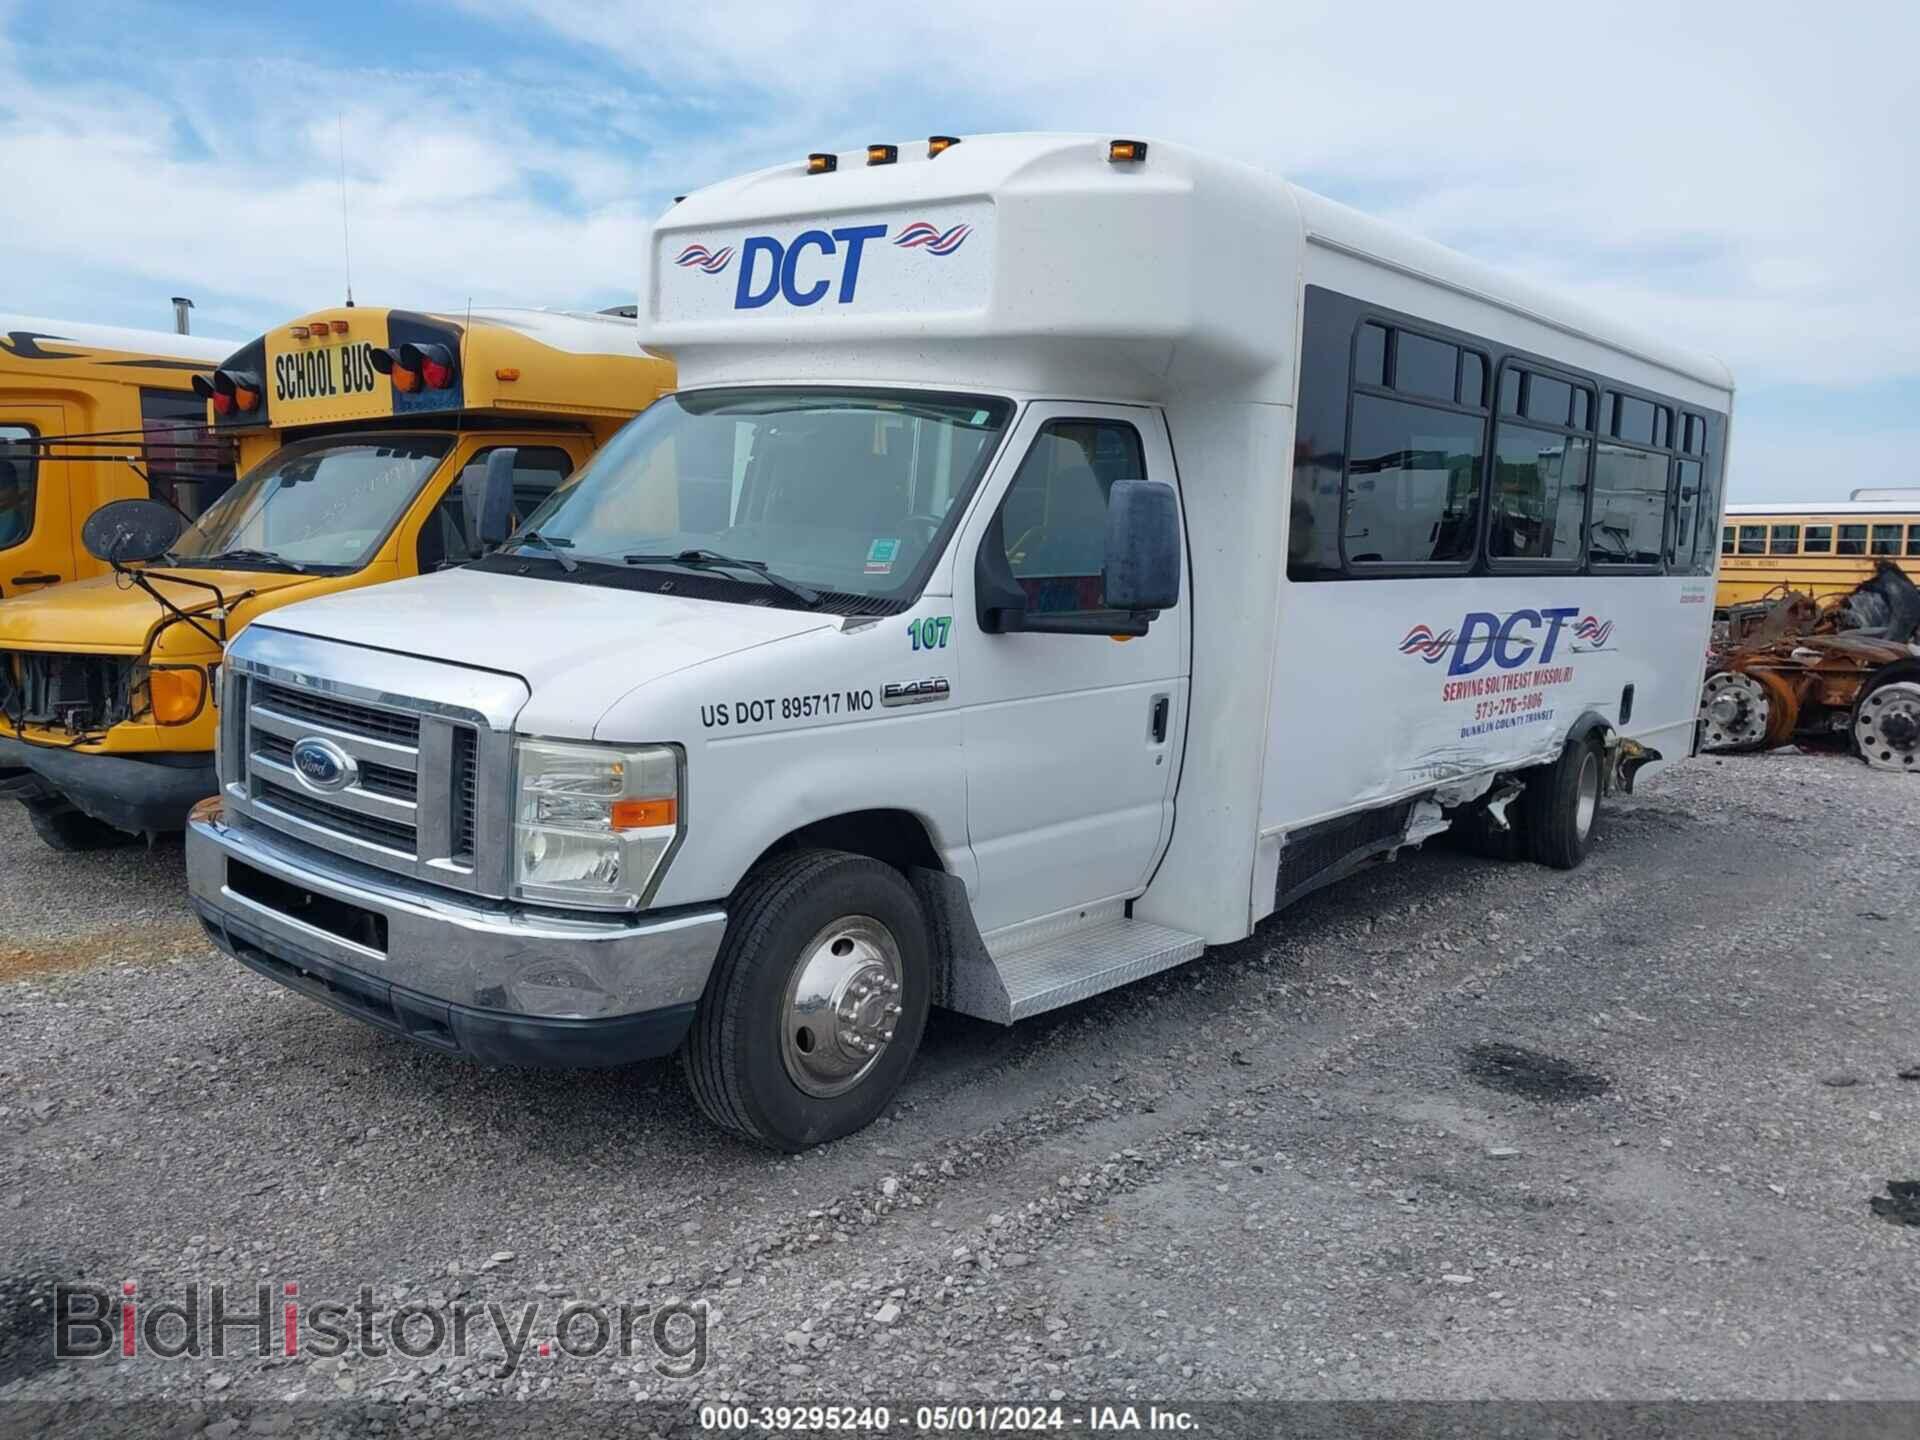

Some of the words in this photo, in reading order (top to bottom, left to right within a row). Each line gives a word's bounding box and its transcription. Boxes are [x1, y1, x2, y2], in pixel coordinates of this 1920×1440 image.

[735, 224, 888, 309] DCT
[276, 349, 336, 400] SCHOOL
[342, 343, 374, 393] BUS
[908, 616, 952, 651] 107
[1447, 607, 1580, 676] DCT
[1442, 678, 1483, 702] SERVING
[1485, 671, 1533, 695] SOUTHEAST
[1534, 666, 1574, 686] MISSOURI
[701, 704, 729, 727] US
[736, 699, 775, 724] DOT
[782, 693, 841, 719] 895717
[847, 690, 873, 712] MO
[1460, 719, 1494, 738] DUNKLIN
[1495, 715, 1524, 730] COUNTY
[1525, 709, 1554, 723] TRANSIT
[301, 750, 328, 777] Ford
